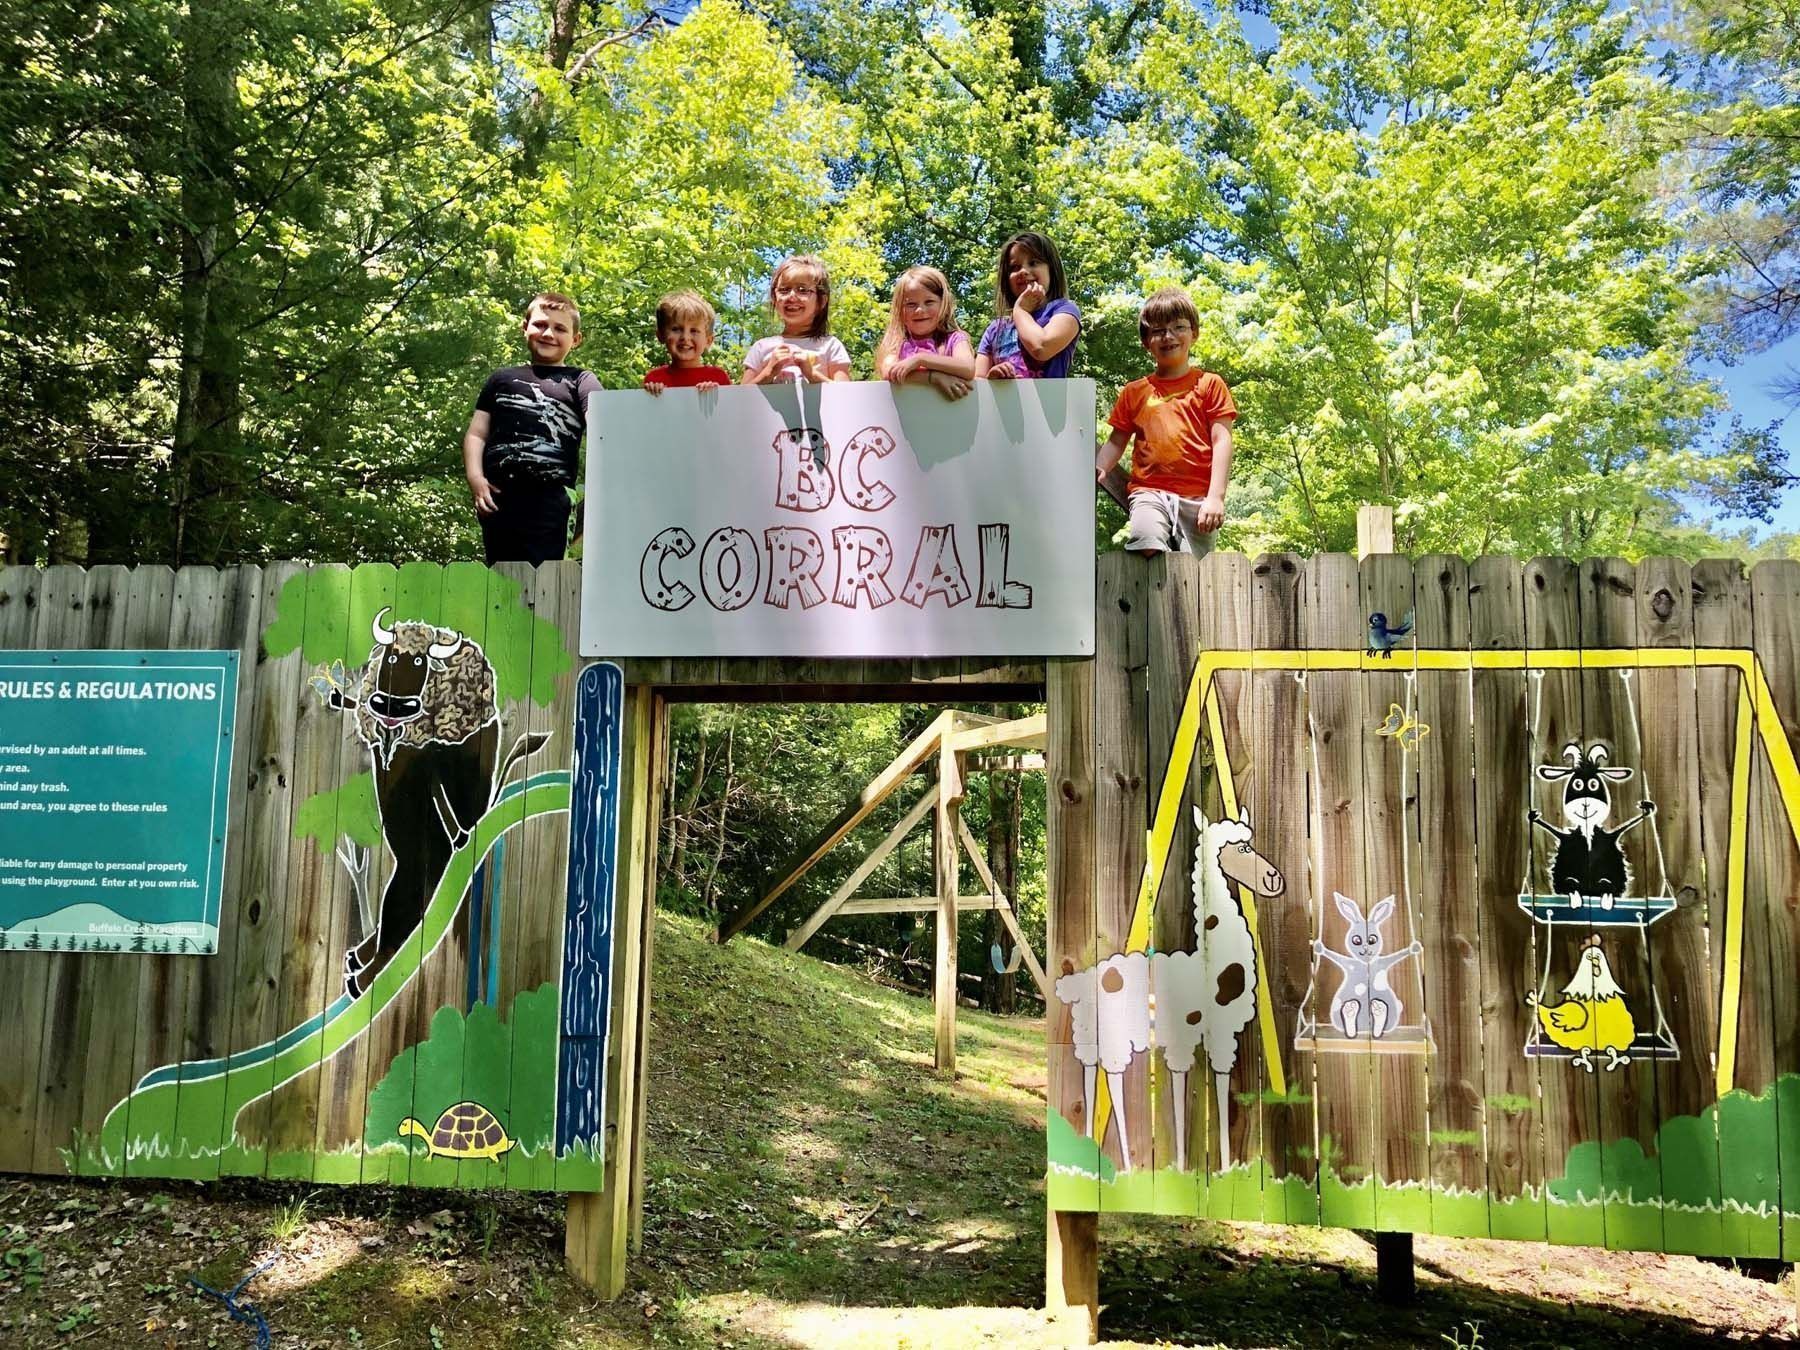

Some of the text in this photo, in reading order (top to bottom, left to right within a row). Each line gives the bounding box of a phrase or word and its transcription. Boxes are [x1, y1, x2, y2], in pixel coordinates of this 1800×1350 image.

[772, 426, 896, 512] BC
[640, 523, 1033, 611] CORRAL
[0, 681, 216, 700] RULES & REGULATIONS
[33, 744, 46, 757] by
[48, 747, 60, 755] an
[62, 745, 87, 755] adult
[89, 746, 99, 755] at
[101, 746, 114, 756] all
[116, 746, 147, 756] times.
[5, 765, 30, 773] area.
[20, 784, 39, 794] any
[41, 782, 70, 792] trash.
[20, 803, 46, 812] area,
[48, 803, 66, 813] you
[68, 804, 97, 813] agree
[99, 803, 109, 811] to
[112, 802, 139, 812] these
[142, 802, 168, 812] rules
[24, 859, 38, 869] for
[39, 862, 56, 870] any
[57, 860, 93, 871] damage
[94, 861, 105, 870] to
[105, 861, 146, 872] personal
[147, 862, 188, 872] property
[1, 876, 26, 886] using
[28, 876, 43, 886] the
[44, 877, 98, 888] playground.
[101, 877, 126, 887] Enter
[128, 878, 138, 887] at
[139, 880, 156, 889] you
[179, 879, 200, 888] risk.
[88, 923, 122, 933] Buffalo
